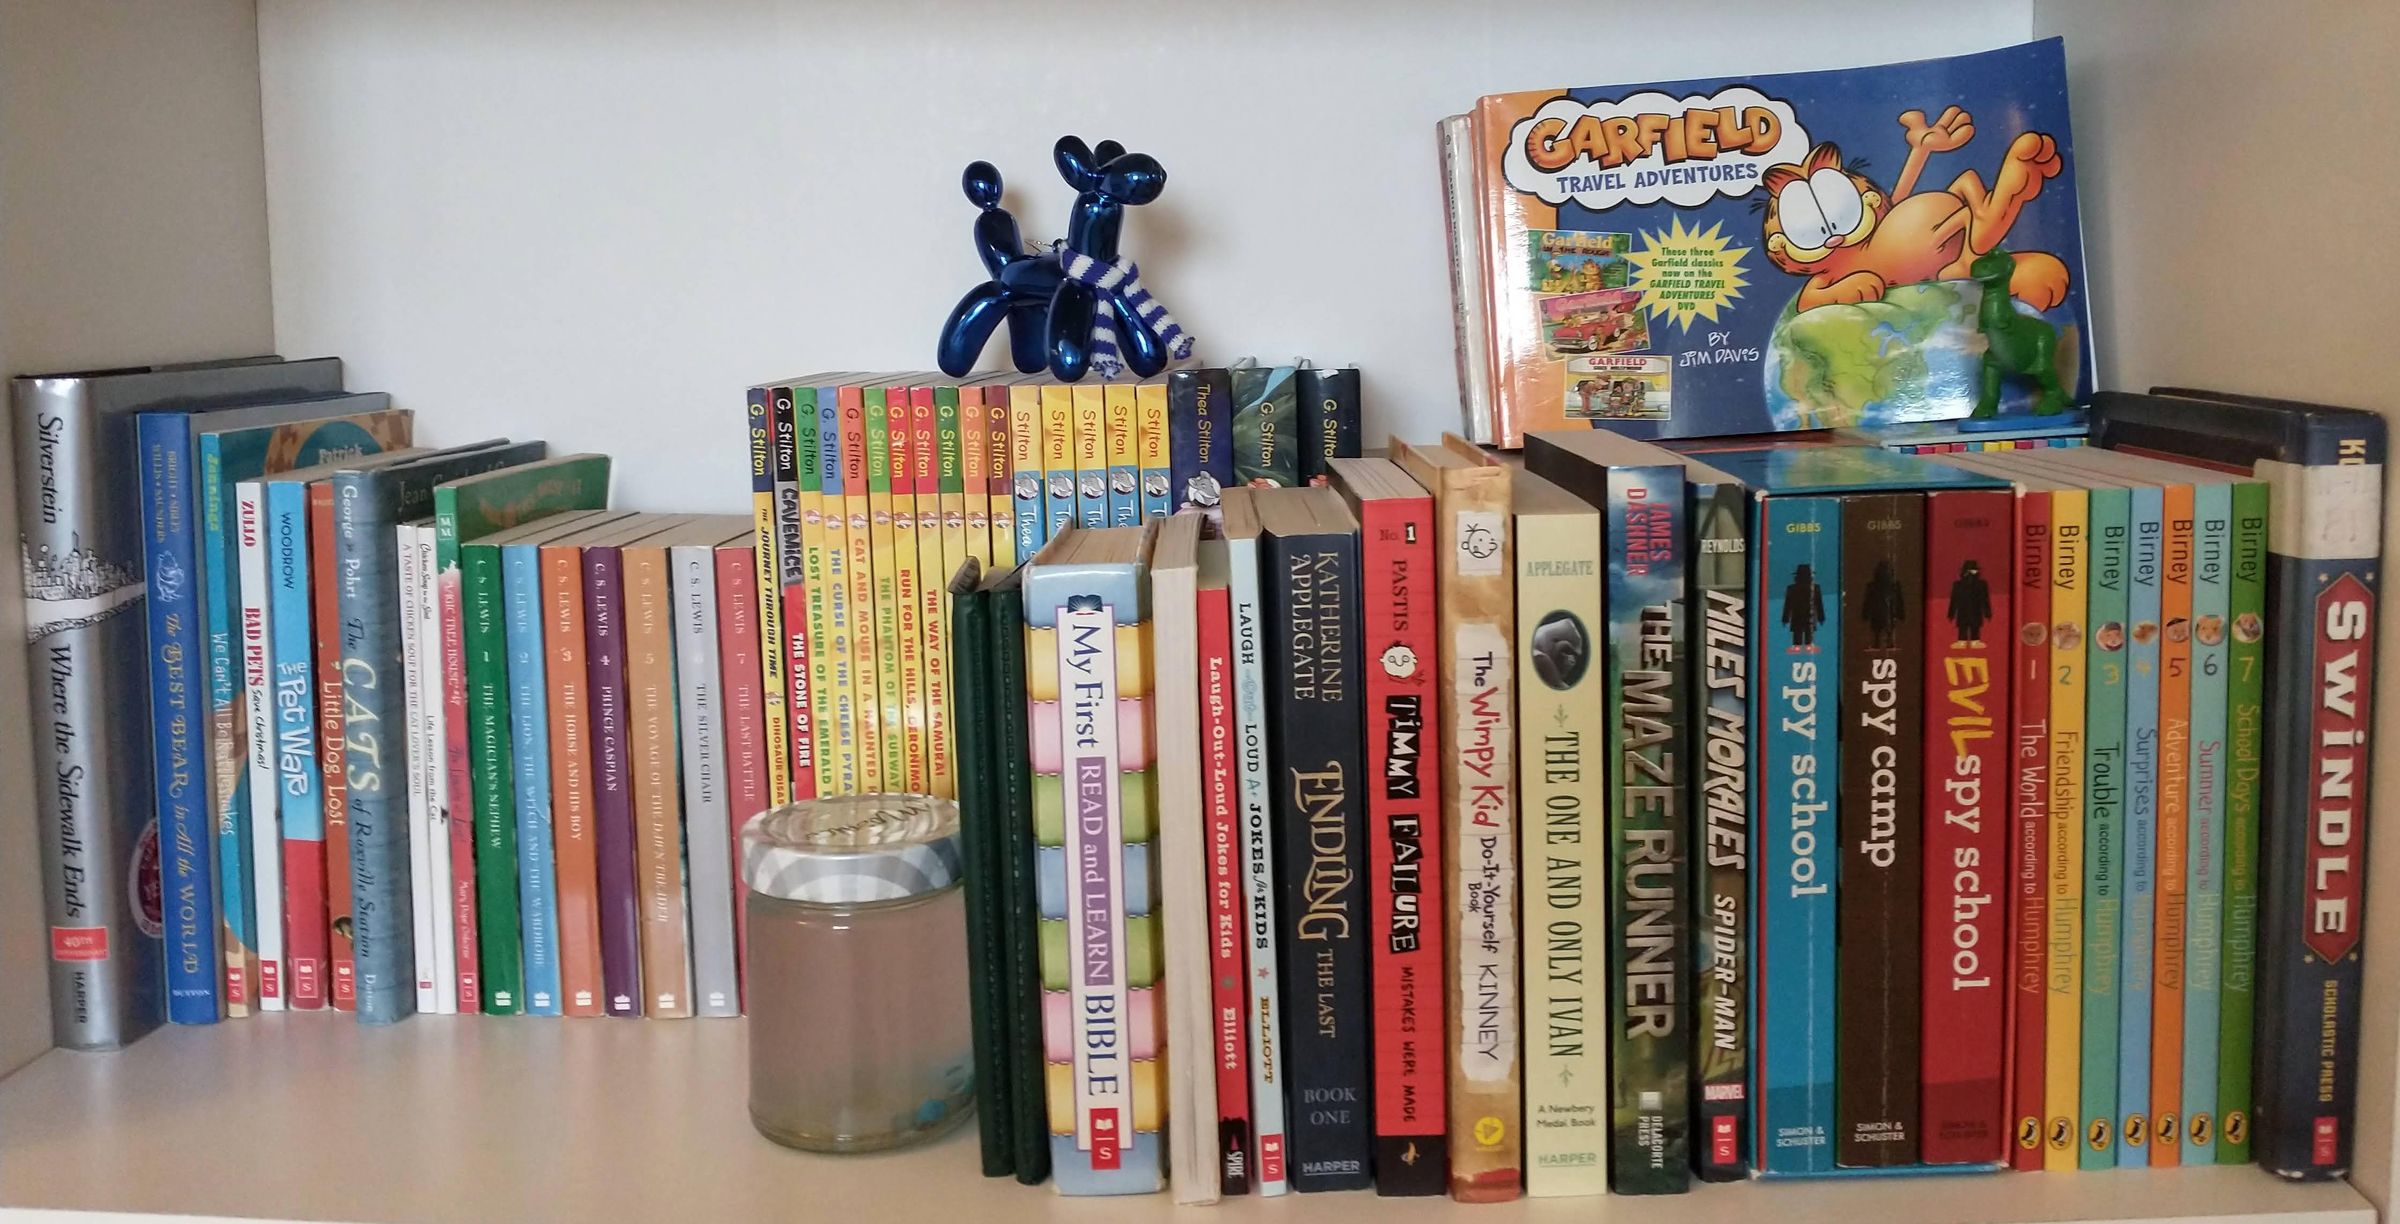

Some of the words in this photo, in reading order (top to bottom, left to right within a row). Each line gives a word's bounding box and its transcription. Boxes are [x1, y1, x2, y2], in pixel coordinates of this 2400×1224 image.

[1525, 105, 1782, 173] GARFIELD
[1556, 174, 1626, 194] TRAVEL
[1634, 163, 1759, 189] ADVENTURES
[1652, 258, 1688, 268] Garfield
[1661, 247, 1687, 256] These
[1690, 247, 1714, 256] three
[1650, 279, 1692, 289] GARFIELD
[1694, 279, 1725, 289] TRAVEL
[1660, 290, 1715, 300] ADVENTURES
[1677, 301, 1696, 311] DVD
[1588, 357, 1647, 366] GARFIELD
[1708, 331, 1731, 347] BY
[1196, 384, 1210, 415] Thea
[752, 427, 769, 476] Stilton
[779, 422, 792, 470] Stilton
[802, 427, 816, 475] Stilton
[823, 432, 837, 479] Stilton
[1017, 411, 1030, 460] Stilton
[1052, 410, 1066, 459] Stilton
[1083, 410, 1096, 459] Stilton
[1114, 405, 1127, 455] Stilton
[1147, 408, 1160, 458] Stilton
[38, 413, 64, 525] Silverstein
[242, 500, 257, 547] ZULLO
[343, 485, 358, 539] George
[782, 488, 803, 578] CAVEMICE
[1625, 488, 1649, 576] DASHNER
[1650, 502, 1672, 561] JAMES
[1786, 523, 1821, 532] GIBBS
[280, 512, 294, 589] WOODROW
[761, 527, 774, 583] JOURNEY
[808, 547, 821, 580] LOST
[830, 549, 841, 575] THE
[854, 538, 866, 563] CAT
[1526, 560, 1593, 577] APPLEGATE
[1701, 538, 1744, 554] REYNOLDS
[2022, 524, 2047, 590] Birney
[2055, 525, 2080, 590] Birney
[2100, 526, 2125, 591] Birney
[2135, 521, 2160, 587] Birney
[2167, 519, 2193, 585] Birney
[2200, 519, 2225, 585] Birney
[2237, 517, 2262, 584] Birney
[832, 583, 846, 627] CURSE
[901, 569, 912, 598] RUN
[927, 589, 938, 614] THE
[1391, 560, 1410, 632] PASTIS
[245, 607, 262, 641] BAD
[346, 618, 364, 650] The
[692, 593, 703, 634] LEWIS
[765, 587, 777, 644] THROUGH
[810, 587, 825, 657] TREASURE
[857, 610, 871, 662] MOUSE
[903, 605, 914, 631] FOR
[928, 620, 941, 651] WAY
[1240, 603, 1255, 665] LAUGH
[1289, 554, 1316, 700] APPLEGATE
[1314, 552, 1343, 702] KATHERINE
[1640, 601, 1673, 662] THE
[247, 645, 265, 686] PETS
[767, 649, 778, 680] TIME
[792, 633, 804, 658] THE
[904, 637, 916, 662] THE
[930, 658, 942, 676] OF
[1067, 624, 1103, 675] My
[1705, 589, 1746, 698] MILES
[50, 643, 72, 714] Where
[794, 664, 807, 709] STONE
[815, 664, 826, 682] OF
[837, 661, 848, 686] THE
[1473, 652, 1493, 687] The
[279, 675, 308, 722] Pet
[323, 681, 342, 730] Little
[696, 683, 707, 709] THE
[816, 688, 828, 712] THE
[838, 695, 852, 746] CHEESE
[1075, 681, 1105, 748] First
[1783, 662, 1818, 740] spy
[1862, 658, 1897, 736] spy
[1944, 656, 1994, 761] EVIL
[56, 721, 73, 754] the
[341, 657, 381, 792] CATS
[698, 715, 710, 760] SILVER
[772, 717, 783, 771] DINOSAUR
[796, 714, 809, 732] OF
[1209, 657, 1229, 816] Laugh-Out-Loud
[1244, 724, 1260, 773] LOUD
[1463, 688, 1500, 778] Wimpy
[1621, 671, 1675, 818] MAZE
[2020, 718, 2047, 758] The
[2236, 703, 2258, 761] School
[324, 736, 345, 778] Dog,
[567, 760, 579, 787] AND
[798, 738, 811, 768] FIRE
[818, 720, 832, 784] EMERALD
[1544, 732, 1580, 784] THE
[2049, 731, 2080, 820] Friendship
[2131, 726, 2157, 815] Surprises
[2166, 718, 2188, 812] Adventure
[2198, 740, 2220, 812] Summer
[328, 786, 346, 826] Lost
[1080, 764, 1104, 835] READ
[1472, 785, 1504, 827] Kid
[1703, 706, 1746, 870] MORALES
[1861, 745, 1897, 867] camp
[1946, 754, 1982, 834] spy
[2020, 766, 2047, 818] World
[2093, 743, 2121, 819] Trouble
[58, 761, 84, 856] Sidewalk
[1545, 795, 1581, 844] ONE
[1791, 754, 1828, 898] school
[1084, 844, 1101, 883] and
[1217, 822, 1231, 876] Jokes
[1250, 803, 1265, 874] JOKES
[1290, 761, 1354, 941] ENDLING
[2022, 821, 2038, 883] according
[63, 864, 86, 918] Ends
[1390, 817, 1423, 953] FAILURE
[1467, 882, 1482, 912] Book
[1480, 837, 1502, 953] Do-It-Yourself
[1546, 856, 1582, 909] AND
[1085, 893, 1109, 978] LEARN
[1219, 915, 1234, 959] Kids
[1254, 896, 1269, 950] KIDS
[1624, 829, 1676, 1040] RUNNER
[1953, 847, 1992, 991] school
[1317, 949, 1335, 987] THE
[1548, 922, 1583, 985] ONLY
[2019, 897, 2044, 993] Humphrey
[2049, 898, 2079, 994] Humphrey
[1714, 894, 1737, 1050] SPIDER-MAN
[1318, 993, 1336, 1039] LAST
[1402, 966, 1417, 1032] MISTAKES
[1478, 963, 1499, 1061] KINNEY
[2320, 980, 2339, 1057] SCHOLASTIC
[1085, 994, 1119, 1096] BIBLE
[1222, 1007, 1238, 1069] Elliott
[1260, 996, 1274, 1084] ELLIOTT
[1549, 996, 1584, 1057] IVAN
[1403, 1040, 1418, 1076] WERE
[1304, 1087, 1357, 1103] BOOK
[1310, 1110, 1351, 1125] ONE
[1403, 1084, 1418, 1122] MADE
[1549, 1104, 1595, 1115] Newbery
[1704, 1085, 1744, 1100] MARVEL
[1638, 1116, 1650, 1146] PRESS
[1776, 1137, 1827, 1148] SCHUSTER
[1854, 1131, 1905, 1142] SCHUSTER
[1302, 1160, 1360, 1174] HARPER
[1538, 1153, 1597, 1164] HARPER
